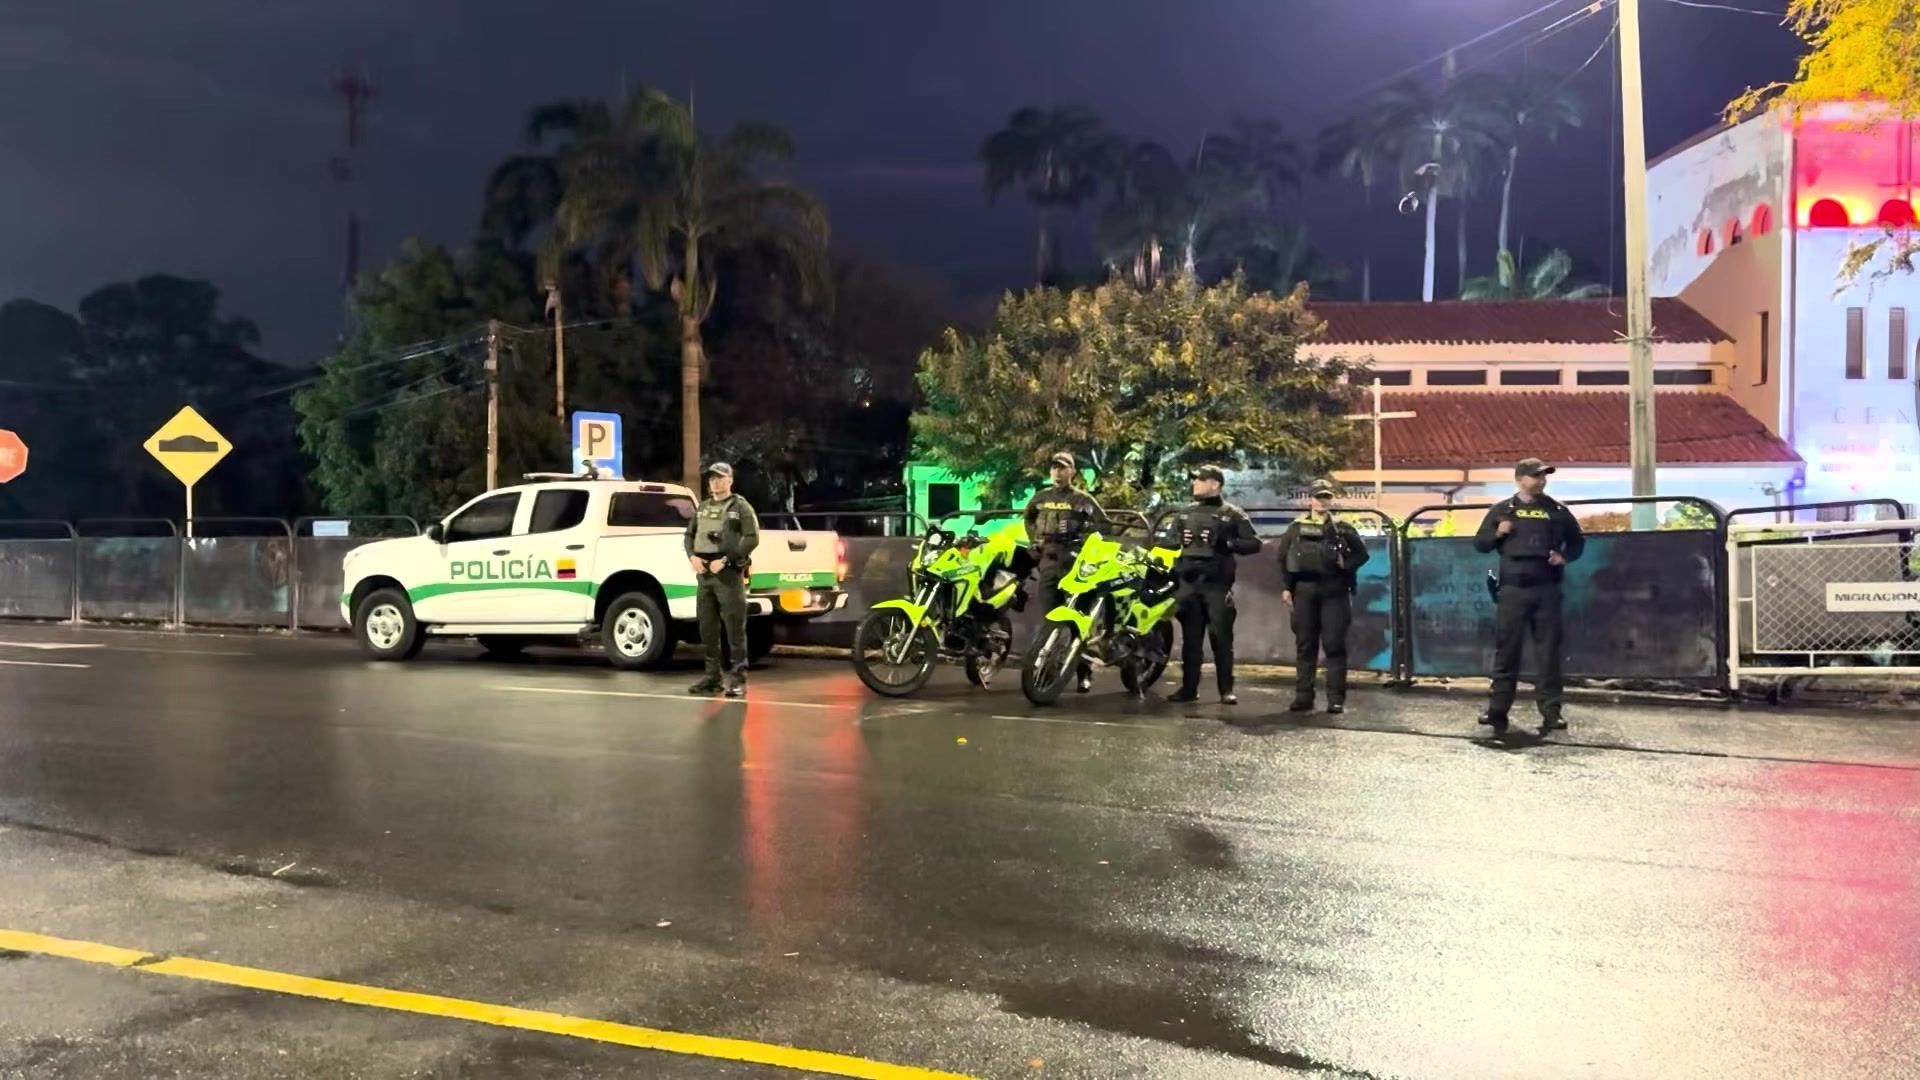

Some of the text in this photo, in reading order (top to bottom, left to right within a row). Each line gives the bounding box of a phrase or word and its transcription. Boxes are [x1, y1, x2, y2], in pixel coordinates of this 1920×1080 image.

[588, 423, 606, 456] P
[450, 554, 553, 580] POLICÍA
[1835, 592, 1918, 601] MIGRACION
